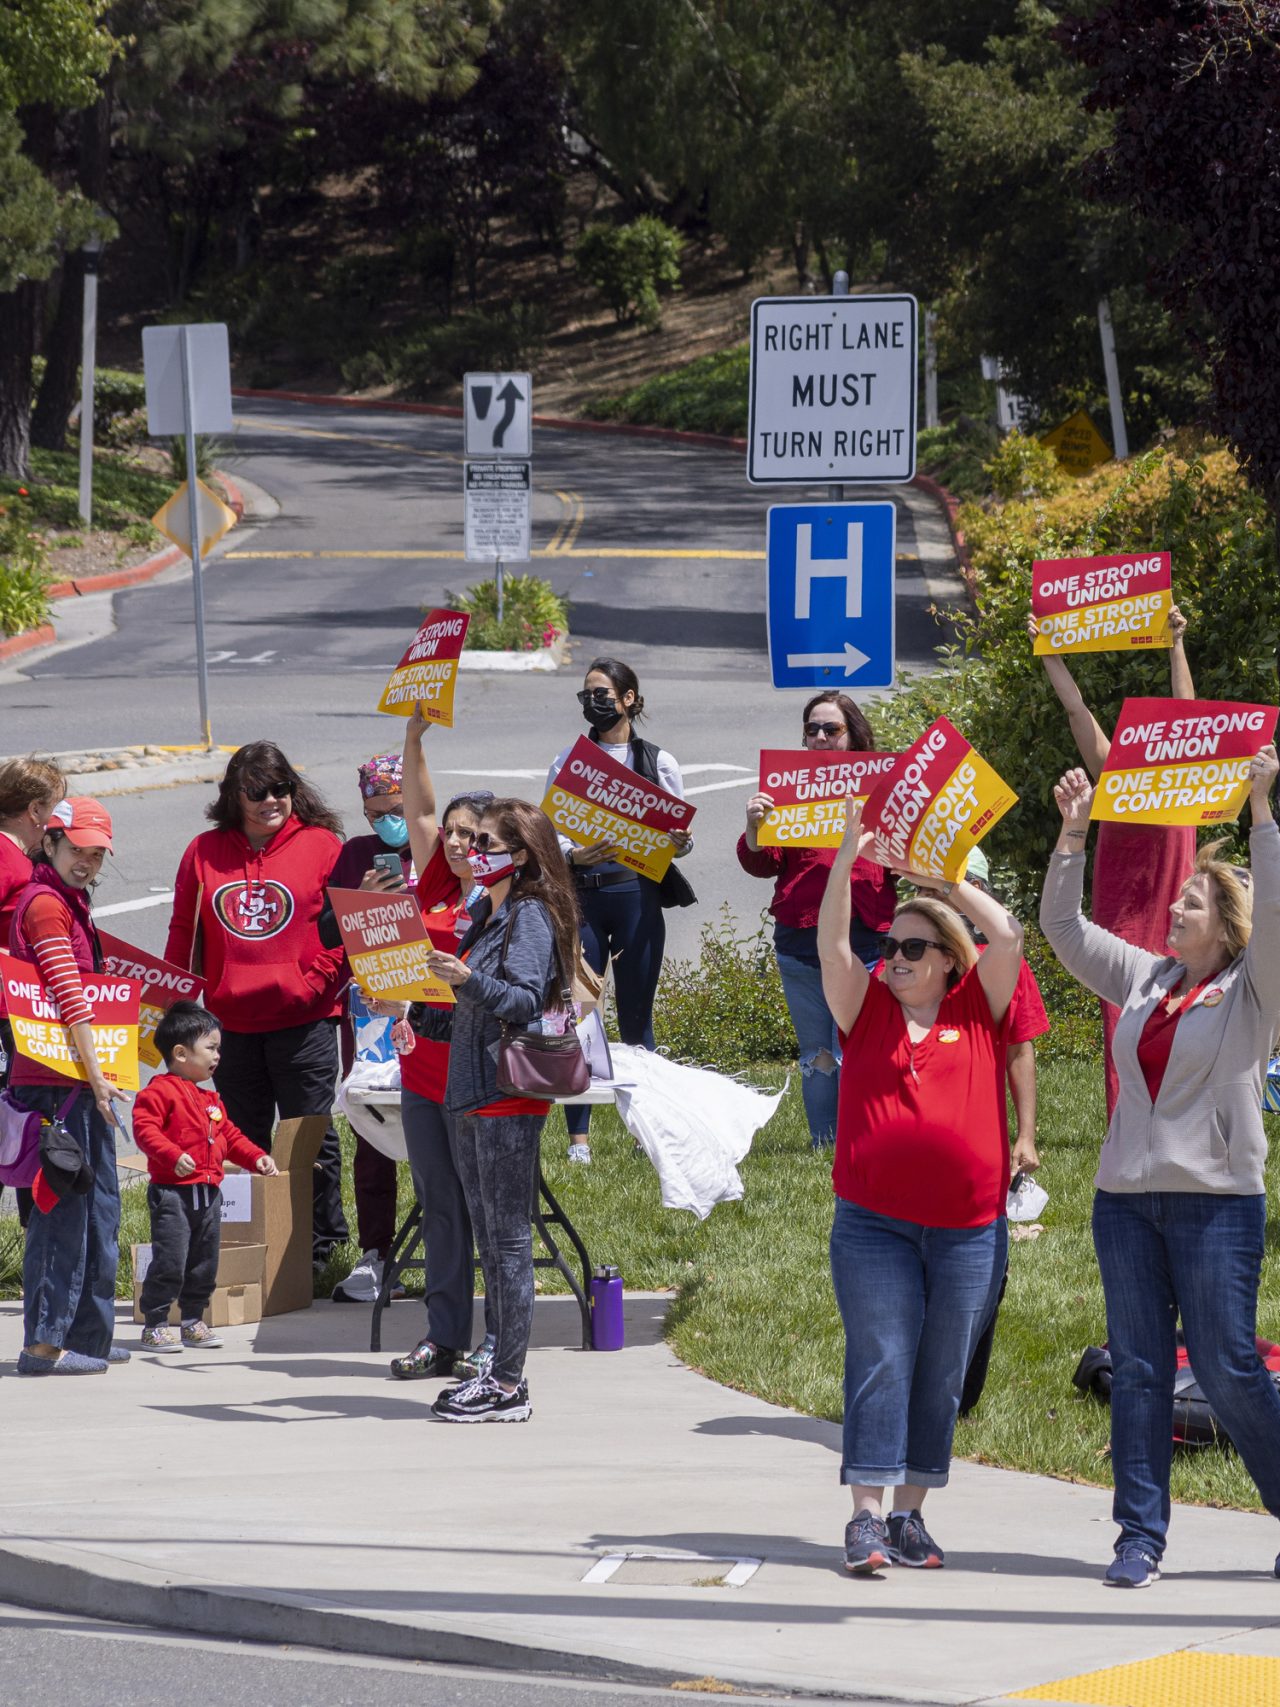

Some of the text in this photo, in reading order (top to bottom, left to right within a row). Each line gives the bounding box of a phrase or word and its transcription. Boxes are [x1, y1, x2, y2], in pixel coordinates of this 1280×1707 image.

[764, 322, 904, 351] RIGHT LANE
[792, 373, 877, 407] MUST
[760, 429, 905, 458] TURN RIGHT
[794, 522, 864, 619] H
[1039, 557, 1162, 598] ONE STRONG
[1066, 580, 1129, 607] UNION
[422, 618, 464, 642] STRONG
[1040, 594, 1162, 636] ONE STRONG
[1050, 612, 1154, 648] CONTRACT
[409, 638, 440, 662] UNION
[388, 663, 452, 688] ONE STRONG
[385, 682, 444, 706] CONTRACT
[1119, 711, 1266, 746] ONE STRONG
[1144, 735, 1220, 762] UNION
[766, 757, 896, 788] ONE STRONG
[796, 777, 861, 800] UNION
[880, 728, 948, 830] STRONG
[1105, 760, 1251, 795] ONE STRONG
[570, 759, 688, 819] ONE STRONG
[586, 784, 649, 820] UNION
[1112, 782, 1240, 814] CONTRACT
[552, 792, 672, 848] ONE STRONG
[765, 806, 810, 826] ONE
[889, 780, 932, 861] UNION
[912, 762, 977, 863] STRONG
[554, 809, 657, 857] CONTRACT
[776, 818, 846, 841] CONTR
[928, 784, 980, 880] NTRACT
[238, 888, 277, 931] SF
[341, 900, 414, 932] ONE STRONG
[362, 923, 400, 947] UNION
[106, 955, 196, 994] STRONG
[354, 944, 430, 976] ONE STRONG
[8, 980, 41, 1001] ONE
[45, 984, 132, 1002] SONG
[366, 964, 432, 992] CONTRACT
[16, 1020, 47, 1043] ONE
[27, 1038, 119, 1064] CONTRCT
